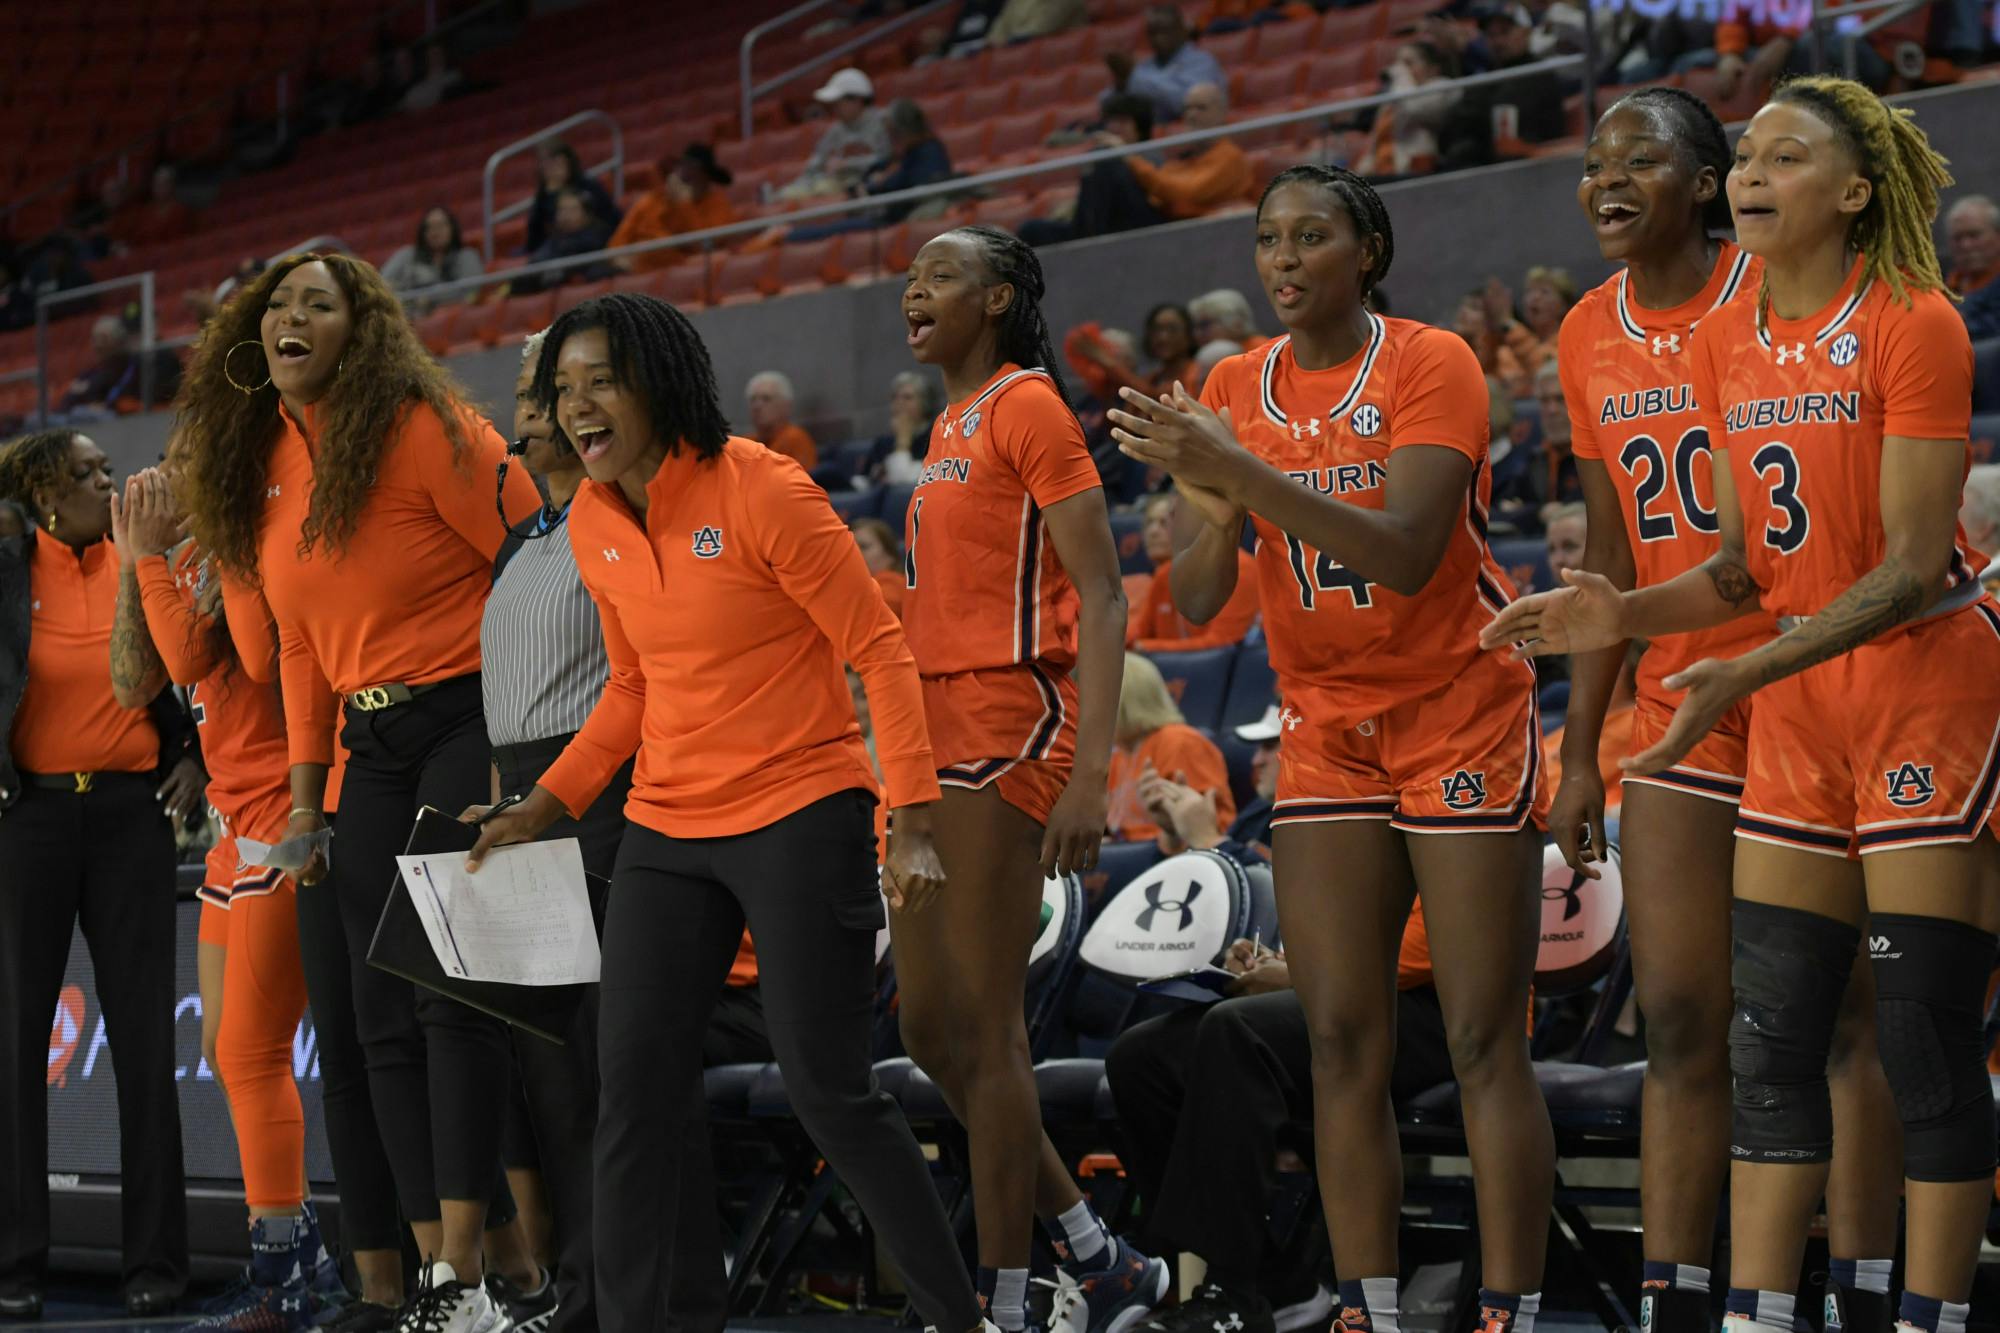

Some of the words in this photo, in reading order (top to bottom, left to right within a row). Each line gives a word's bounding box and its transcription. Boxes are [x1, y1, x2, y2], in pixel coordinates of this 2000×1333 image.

[1830, 333, 1858, 366] SEC
[1352, 404, 1381, 436] SEC
[1619, 426, 1720, 543] 20
[1751, 441, 1809, 556] 3
[905, 496, 923, 589] 1
[1282, 529, 1376, 611] 14
